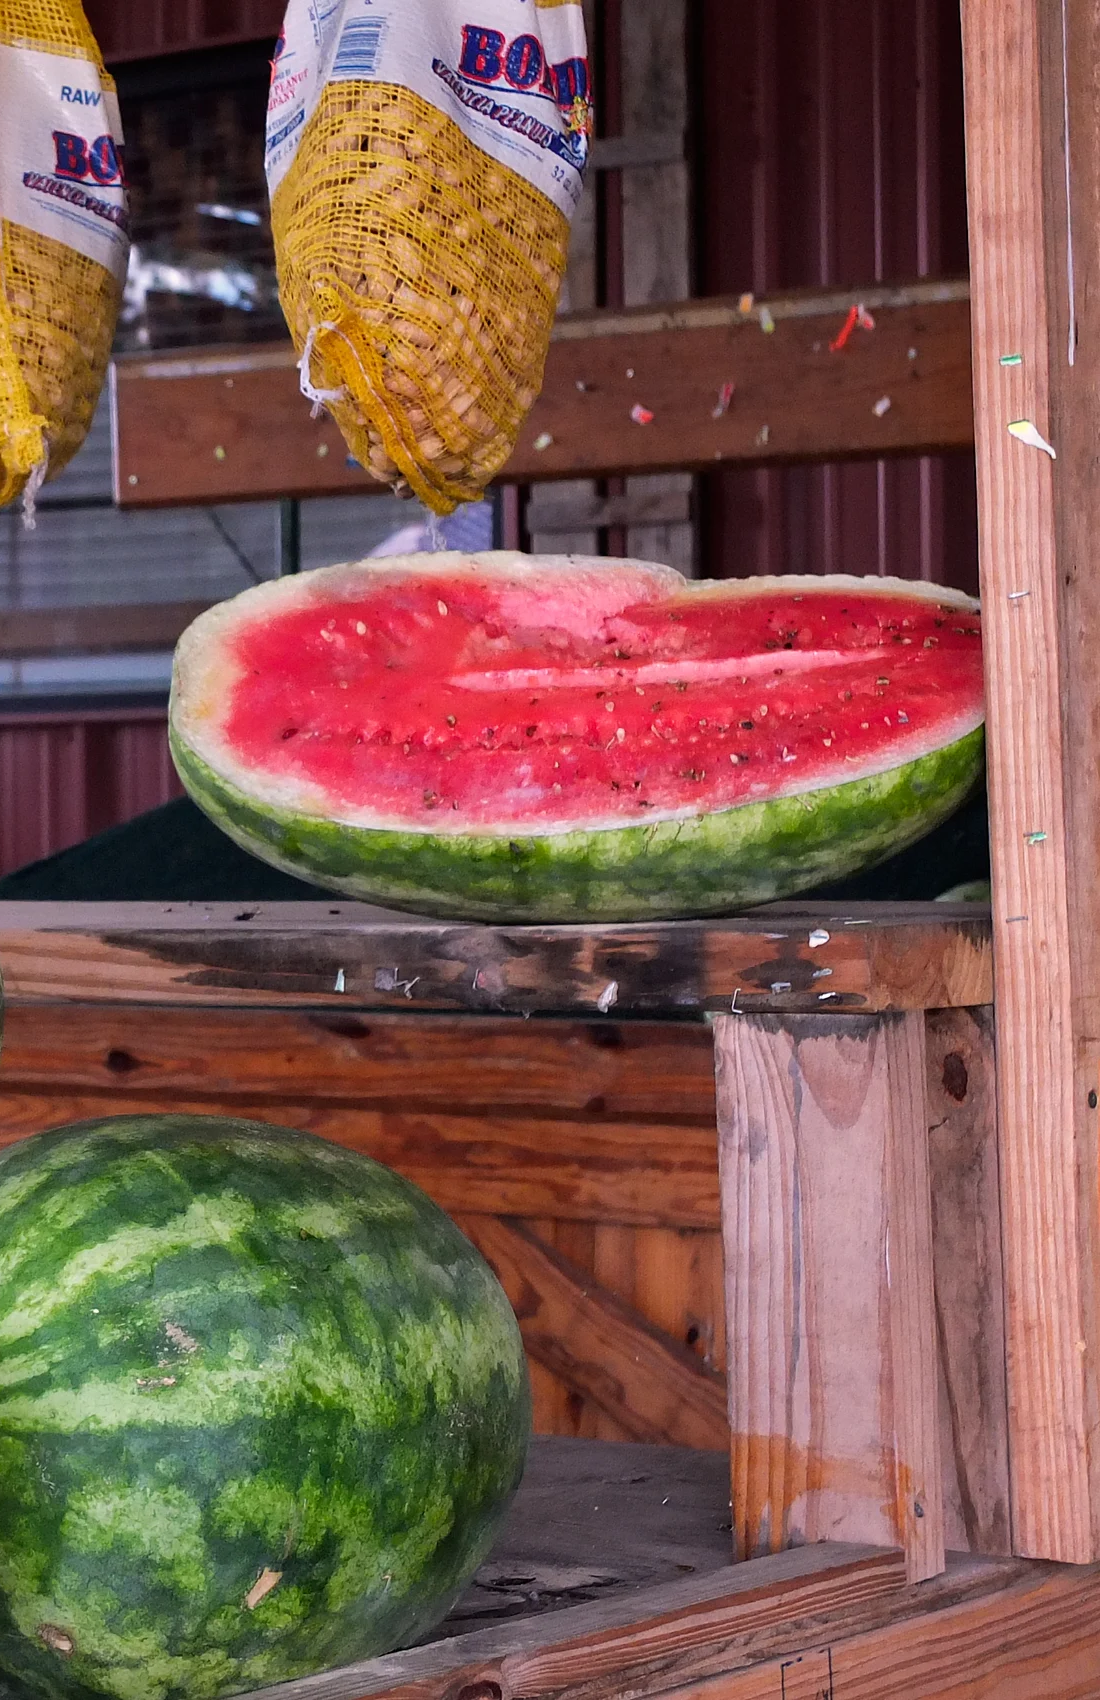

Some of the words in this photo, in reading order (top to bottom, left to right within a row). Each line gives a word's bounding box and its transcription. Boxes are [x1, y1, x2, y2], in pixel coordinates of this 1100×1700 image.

[274, 68, 308, 95] PEANUT
[61, 85, 101, 107] RAW
[431, 57, 496, 117] VALENCIA
[492, 104, 559, 150] PEANUTS
[551, 165, 565, 182] 32
